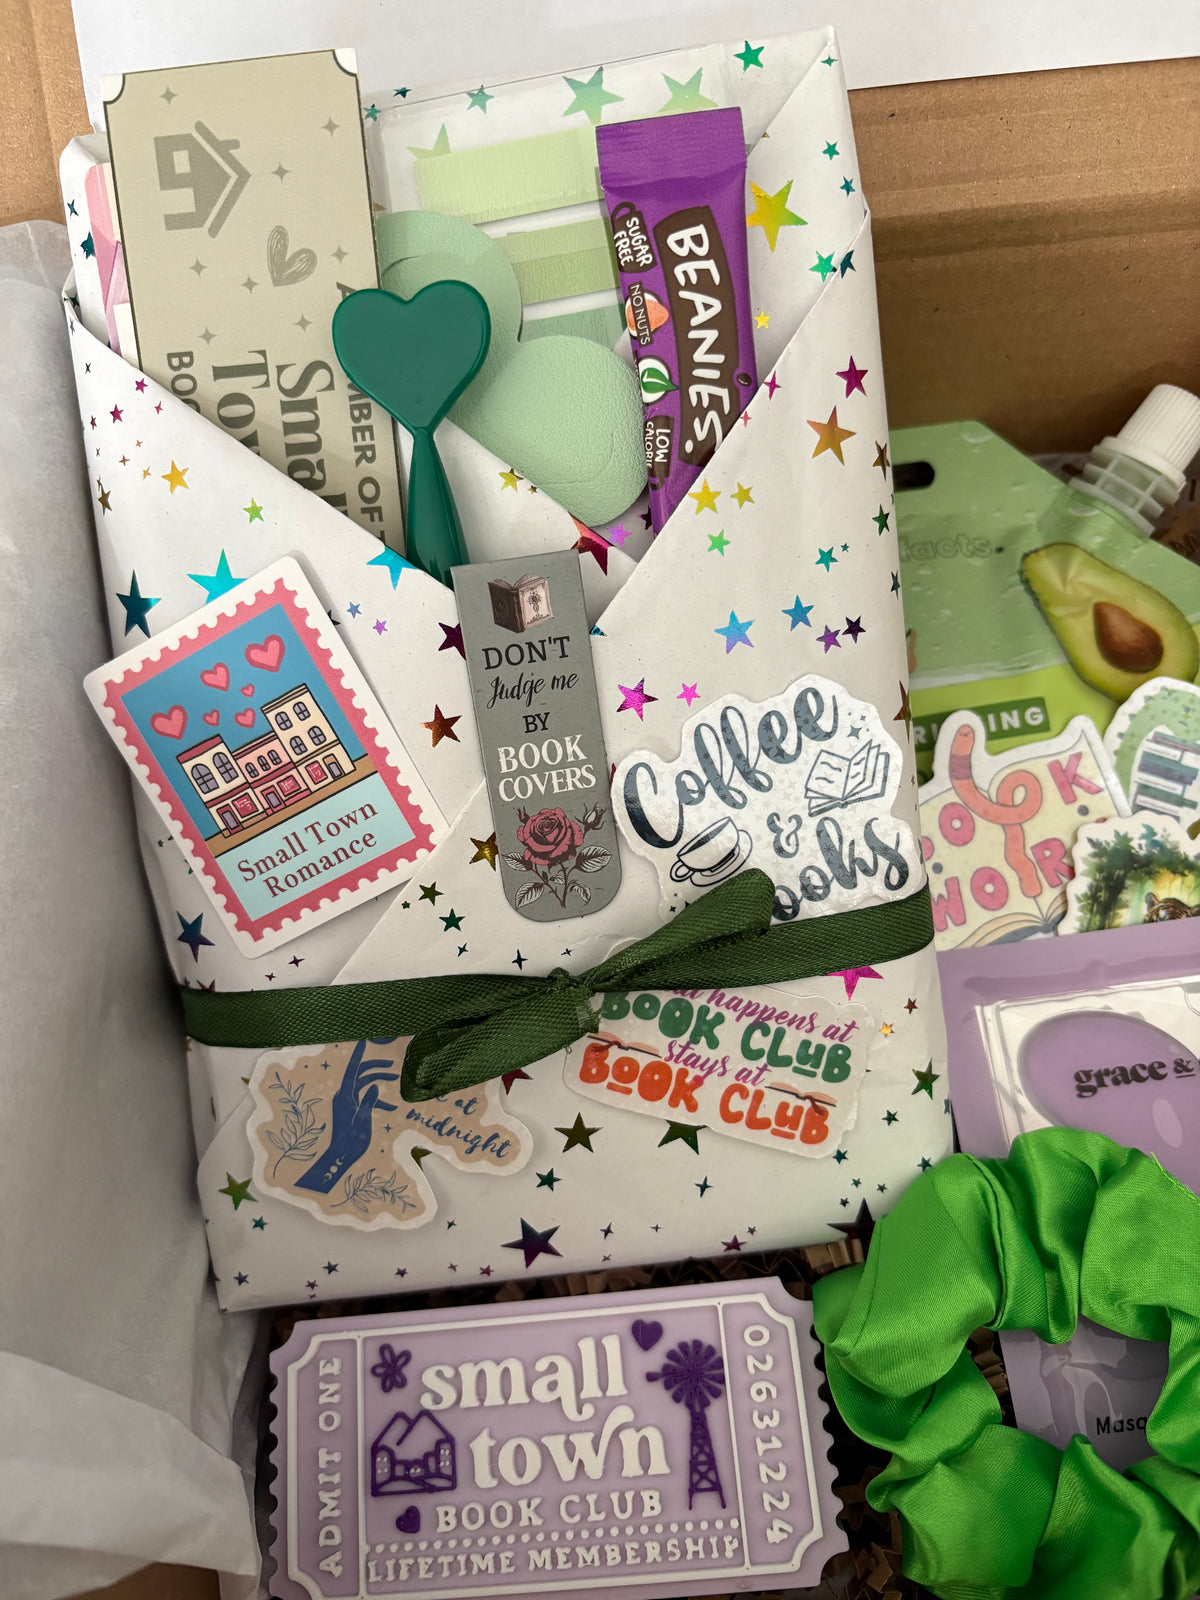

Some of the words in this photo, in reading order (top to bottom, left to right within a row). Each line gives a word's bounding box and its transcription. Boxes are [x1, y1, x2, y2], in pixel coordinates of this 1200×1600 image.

[613, 230, 634, 266] FREE
[625, 216, 653, 268] SUGAR
[630, 284, 643, 307] NO
[635, 308, 651, 345] NUTS
[211, 349, 271, 456] To
[275, 360, 349, 517] Sma
[654, 428, 671, 462] LOW
[357, 476, 385, 523] OF
[481, 636, 571, 670] DON'T
[550, 673, 580, 690] me
[522, 711, 551, 734] BY
[497, 734, 588, 774] BOOK
[623, 687, 839, 849] Coffee
[498, 764, 596, 802] COVERS
[236, 829, 305, 882] Small
[304, 802, 378, 846] Town
[766, 811, 803, 859] &
[262, 829, 378, 898] Romance
[771, 816, 909, 921] ooks
[931, 837, 1077, 933] WOR
[600, 991, 726, 1050] BOOK
[706, 989, 819, 1034] happens
[822, 1020, 860, 1042] at
[579, 1041, 705, 1113] BOOK
[663, 1039, 733, 1078] stays
[734, 1063, 773, 1086] at
[1074, 1060, 1169, 1099] grace
[1172, 1057, 1196, 1079] &
[454, 1097, 478, 1116] at
[406, 1108, 512, 1159] midnight
[318, 1356, 342, 1433] ONE
[419, 1333, 629, 1423] small
[468, 1404, 672, 1489] town
[743, 1324, 794, 1544] 02631224
[318, 1447, 344, 1578] ADMIT
[435, 1496, 545, 1534] BOOK
[559, 1489, 662, 1524] CLUB
[367, 1550, 516, 1584] LIFETIME
[527, 1534, 740, 1573] MEMBERSHIP
